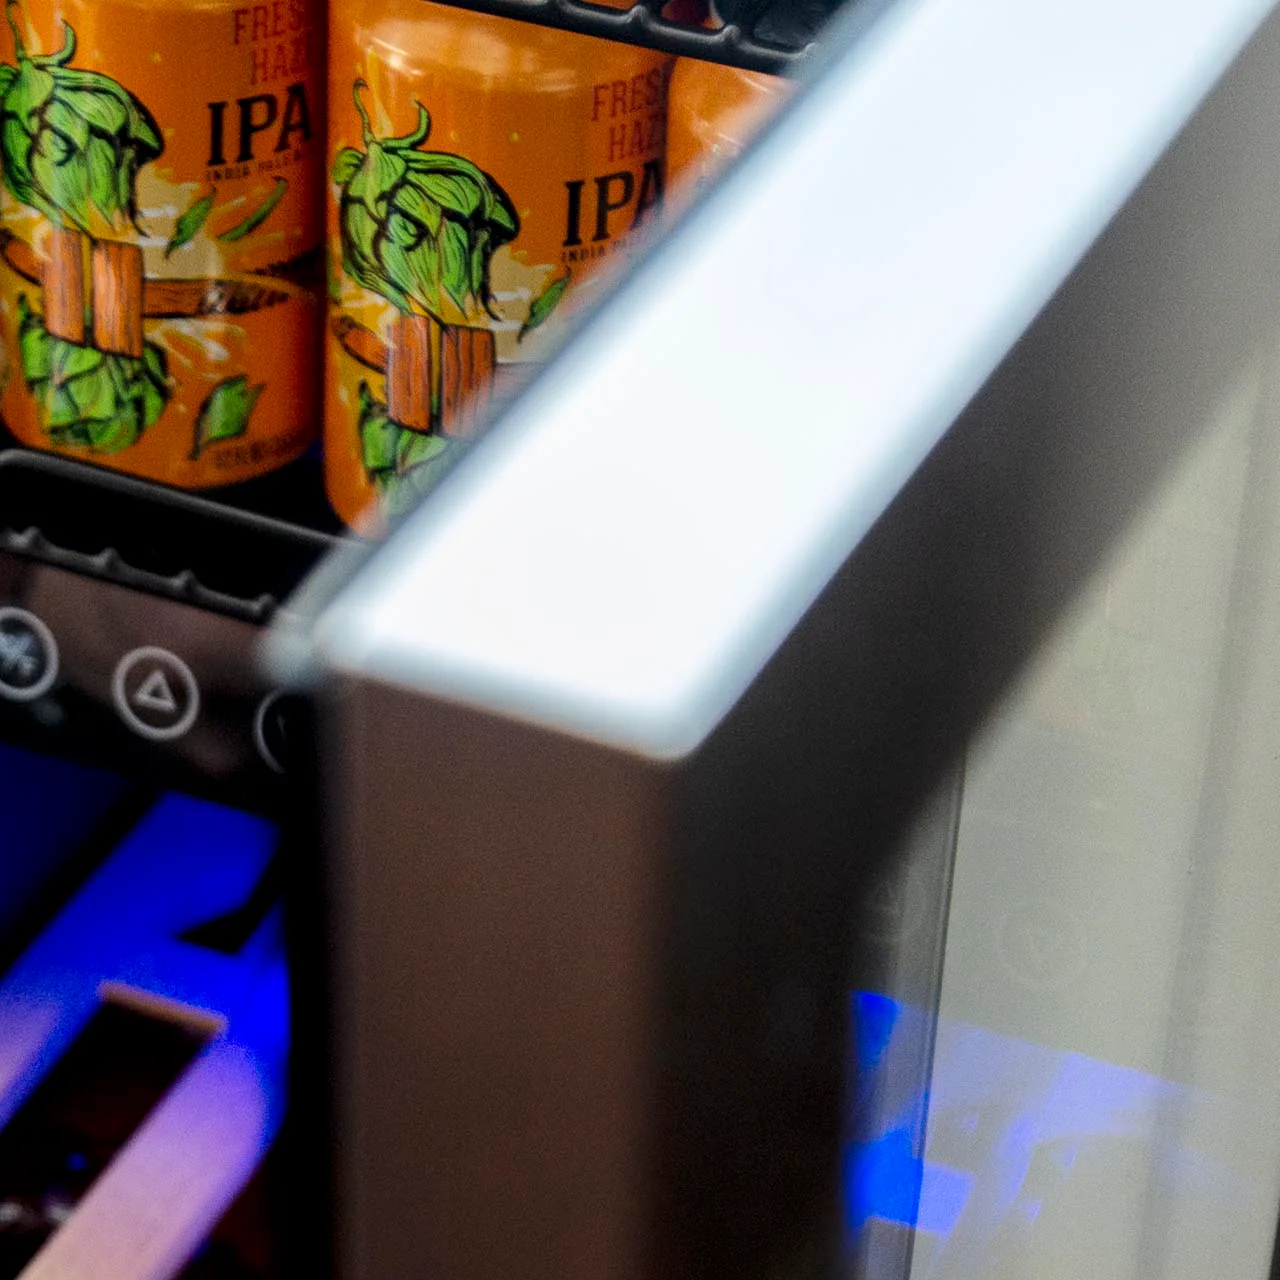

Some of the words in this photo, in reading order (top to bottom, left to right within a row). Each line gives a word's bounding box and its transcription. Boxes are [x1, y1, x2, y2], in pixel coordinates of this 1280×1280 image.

[233, 0, 305, 45] FRES
[207, 83, 313, 166] IPA
[591, 68, 664, 122] FRES
[562, 158, 665, 247] IPA
